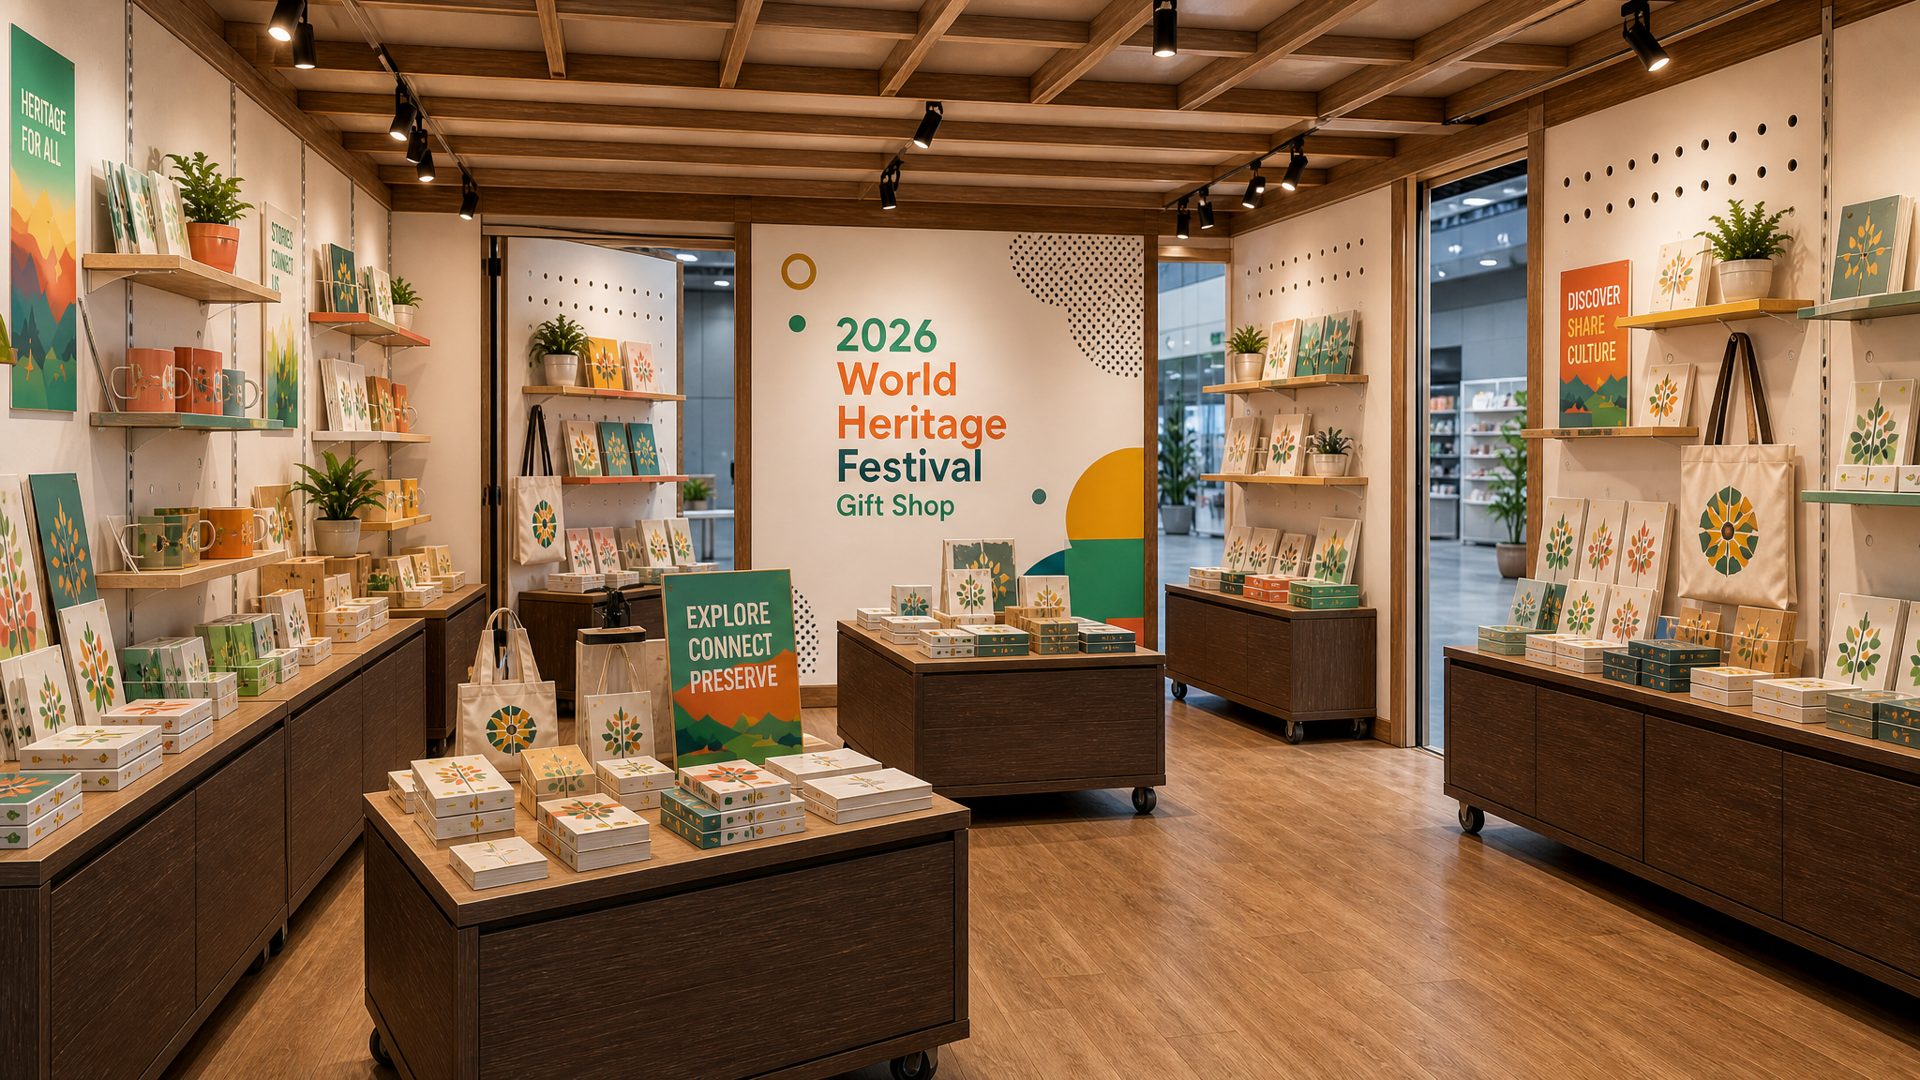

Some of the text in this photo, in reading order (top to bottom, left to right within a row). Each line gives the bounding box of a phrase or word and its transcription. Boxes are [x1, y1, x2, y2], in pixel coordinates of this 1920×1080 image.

[21, 87, 66, 136] HERITAGE
[21, 125, 62, 167] FOR ALL
[1567, 284, 1621, 311] DISCOVER
[836, 316, 938, 353] 2026
[1567, 314, 1606, 338] SHARE
[1567, 340, 1617, 365] CULTURE
[836, 361, 957, 397] World
[837, 404, 1007, 450] Heritage
[837, 447, 982, 483] Festival
[836, 493, 955, 521] Gift Shop
[686, 601, 771, 629] EXPLORE
[688, 632, 773, 662] CONNECT
[690, 664, 778, 694] PRESERVE
